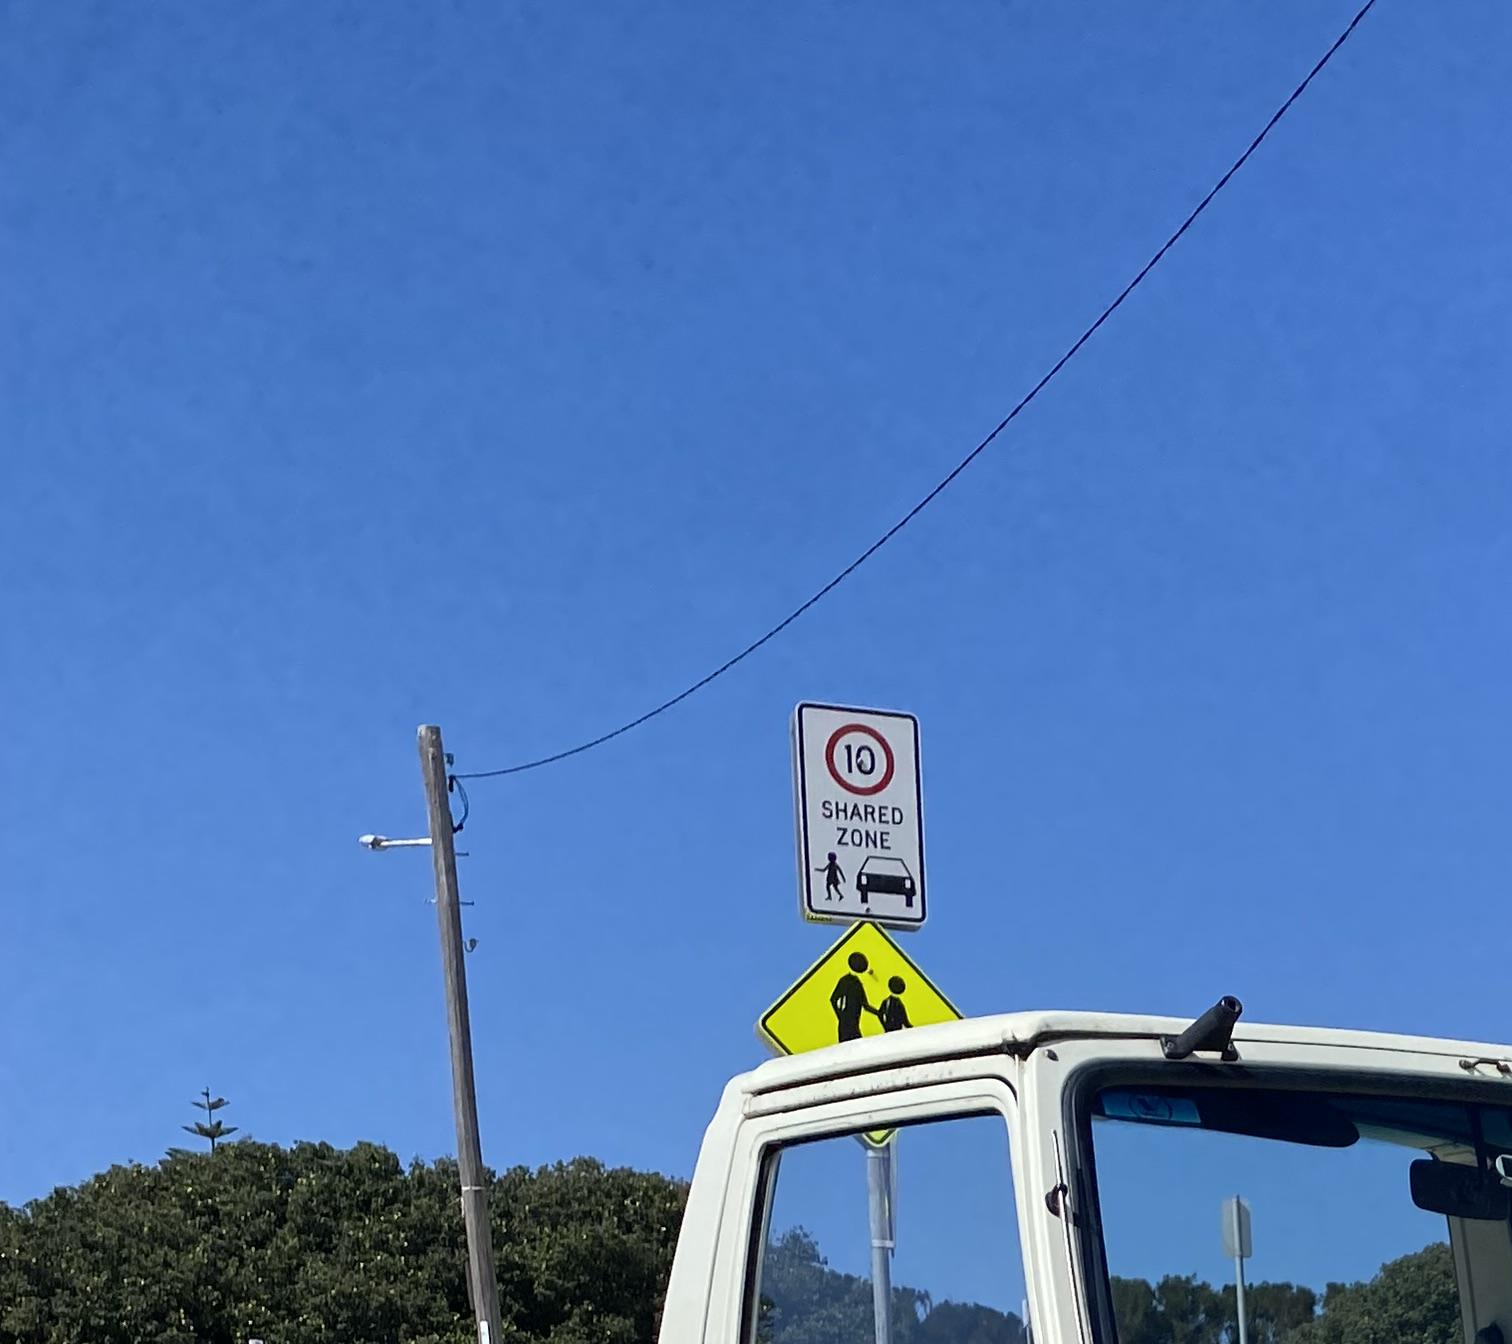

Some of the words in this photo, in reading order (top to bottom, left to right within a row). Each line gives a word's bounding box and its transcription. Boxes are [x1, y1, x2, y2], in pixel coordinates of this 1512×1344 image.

[845, 744, 875, 775] 10
[822, 800, 903, 825] SHARED
[837, 827, 891, 850] ZONE
